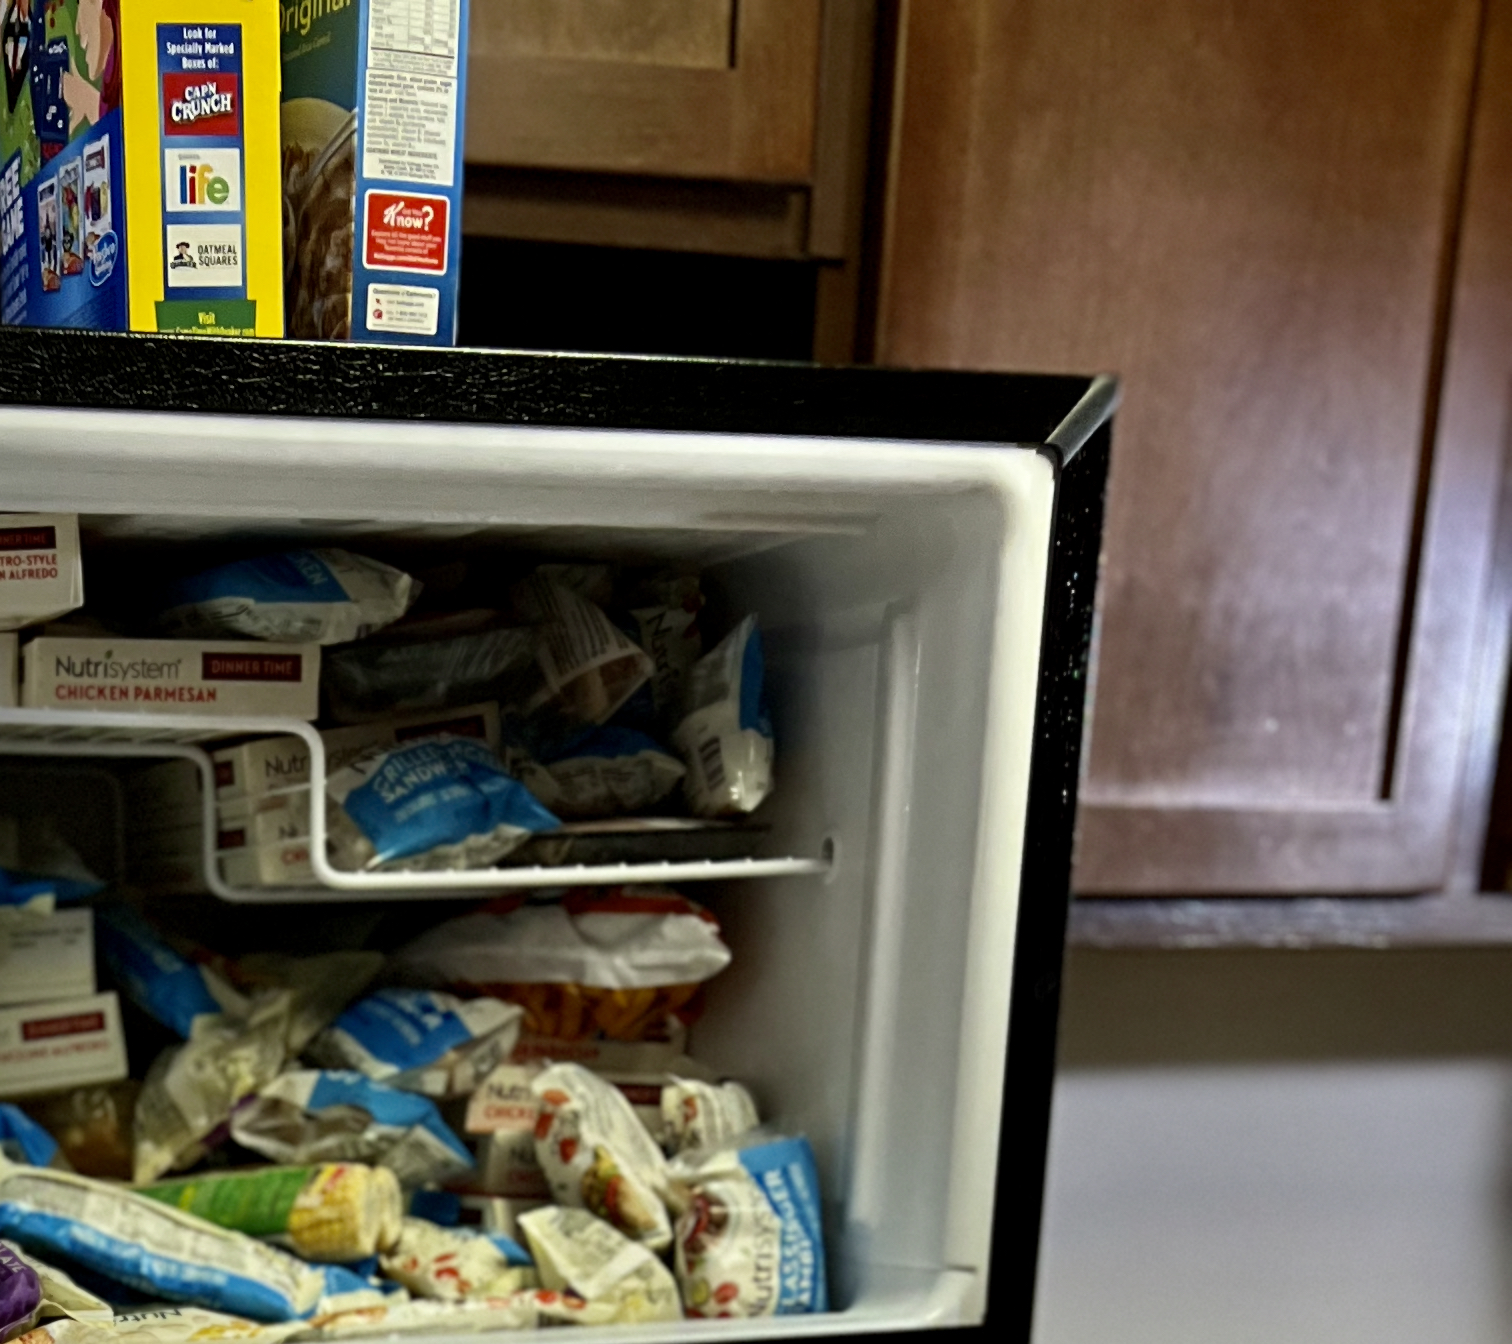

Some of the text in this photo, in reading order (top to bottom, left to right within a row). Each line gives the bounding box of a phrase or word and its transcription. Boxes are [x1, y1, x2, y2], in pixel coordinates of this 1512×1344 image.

[281, 0, 350, 36] rigina
[183, 27, 217, 39] Look for
[167, 42, 235, 55] Specially Marked
[182, 56, 206, 69] Boxes
[171, 93, 233, 122] CRUNCH
[179, 163, 230, 205] life
[197, 244, 237, 255] OATMEAL
[198, 255, 238, 267] SQUARES
[198, 311, 216, 325] Visit
[9, 567, 58, 580] ALFREDO
[211, 659, 293, 675] DINNER TIME
[55, 684, 217, 702] CHICKEN PARMESAN
